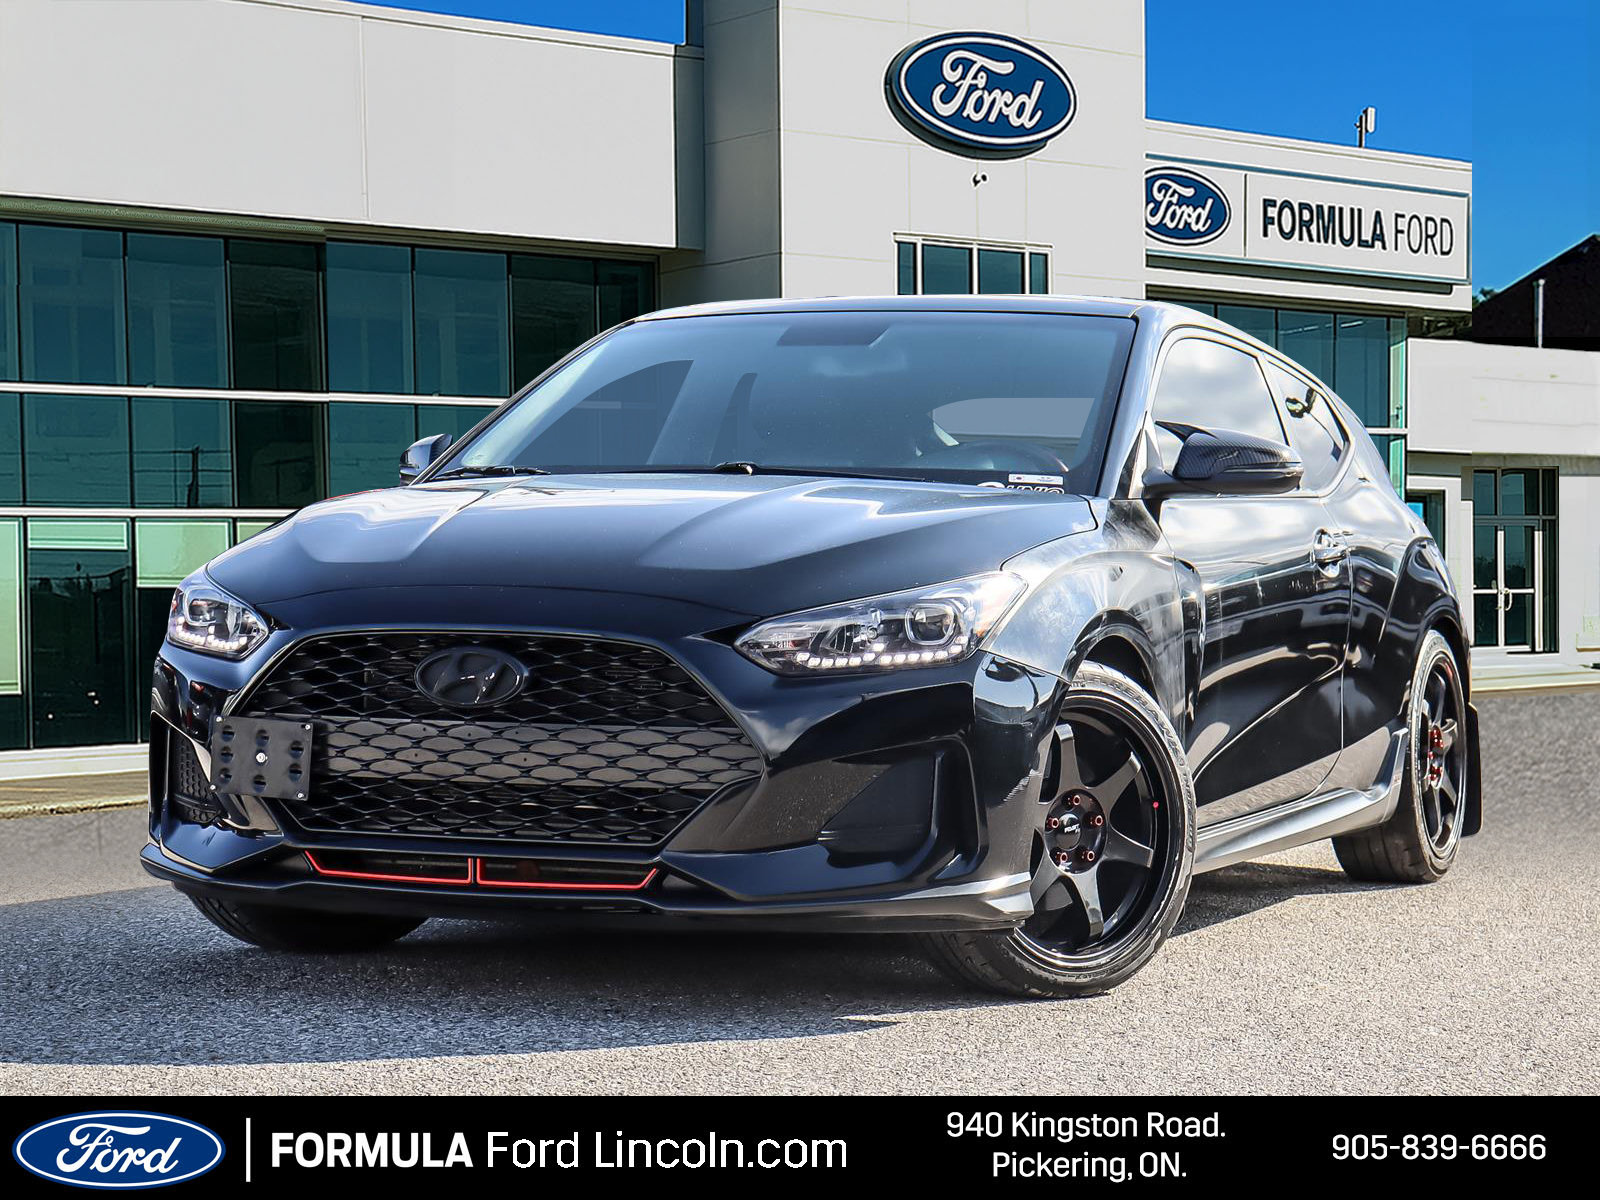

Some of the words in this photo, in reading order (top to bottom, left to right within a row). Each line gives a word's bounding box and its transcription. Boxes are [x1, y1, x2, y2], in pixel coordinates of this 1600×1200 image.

[931, 49, 1045, 129] Ford
[1146, 178, 1214, 233] Ford
[1262, 197, 1387, 251] FORMULA
[1393, 212, 1454, 257] FORD
